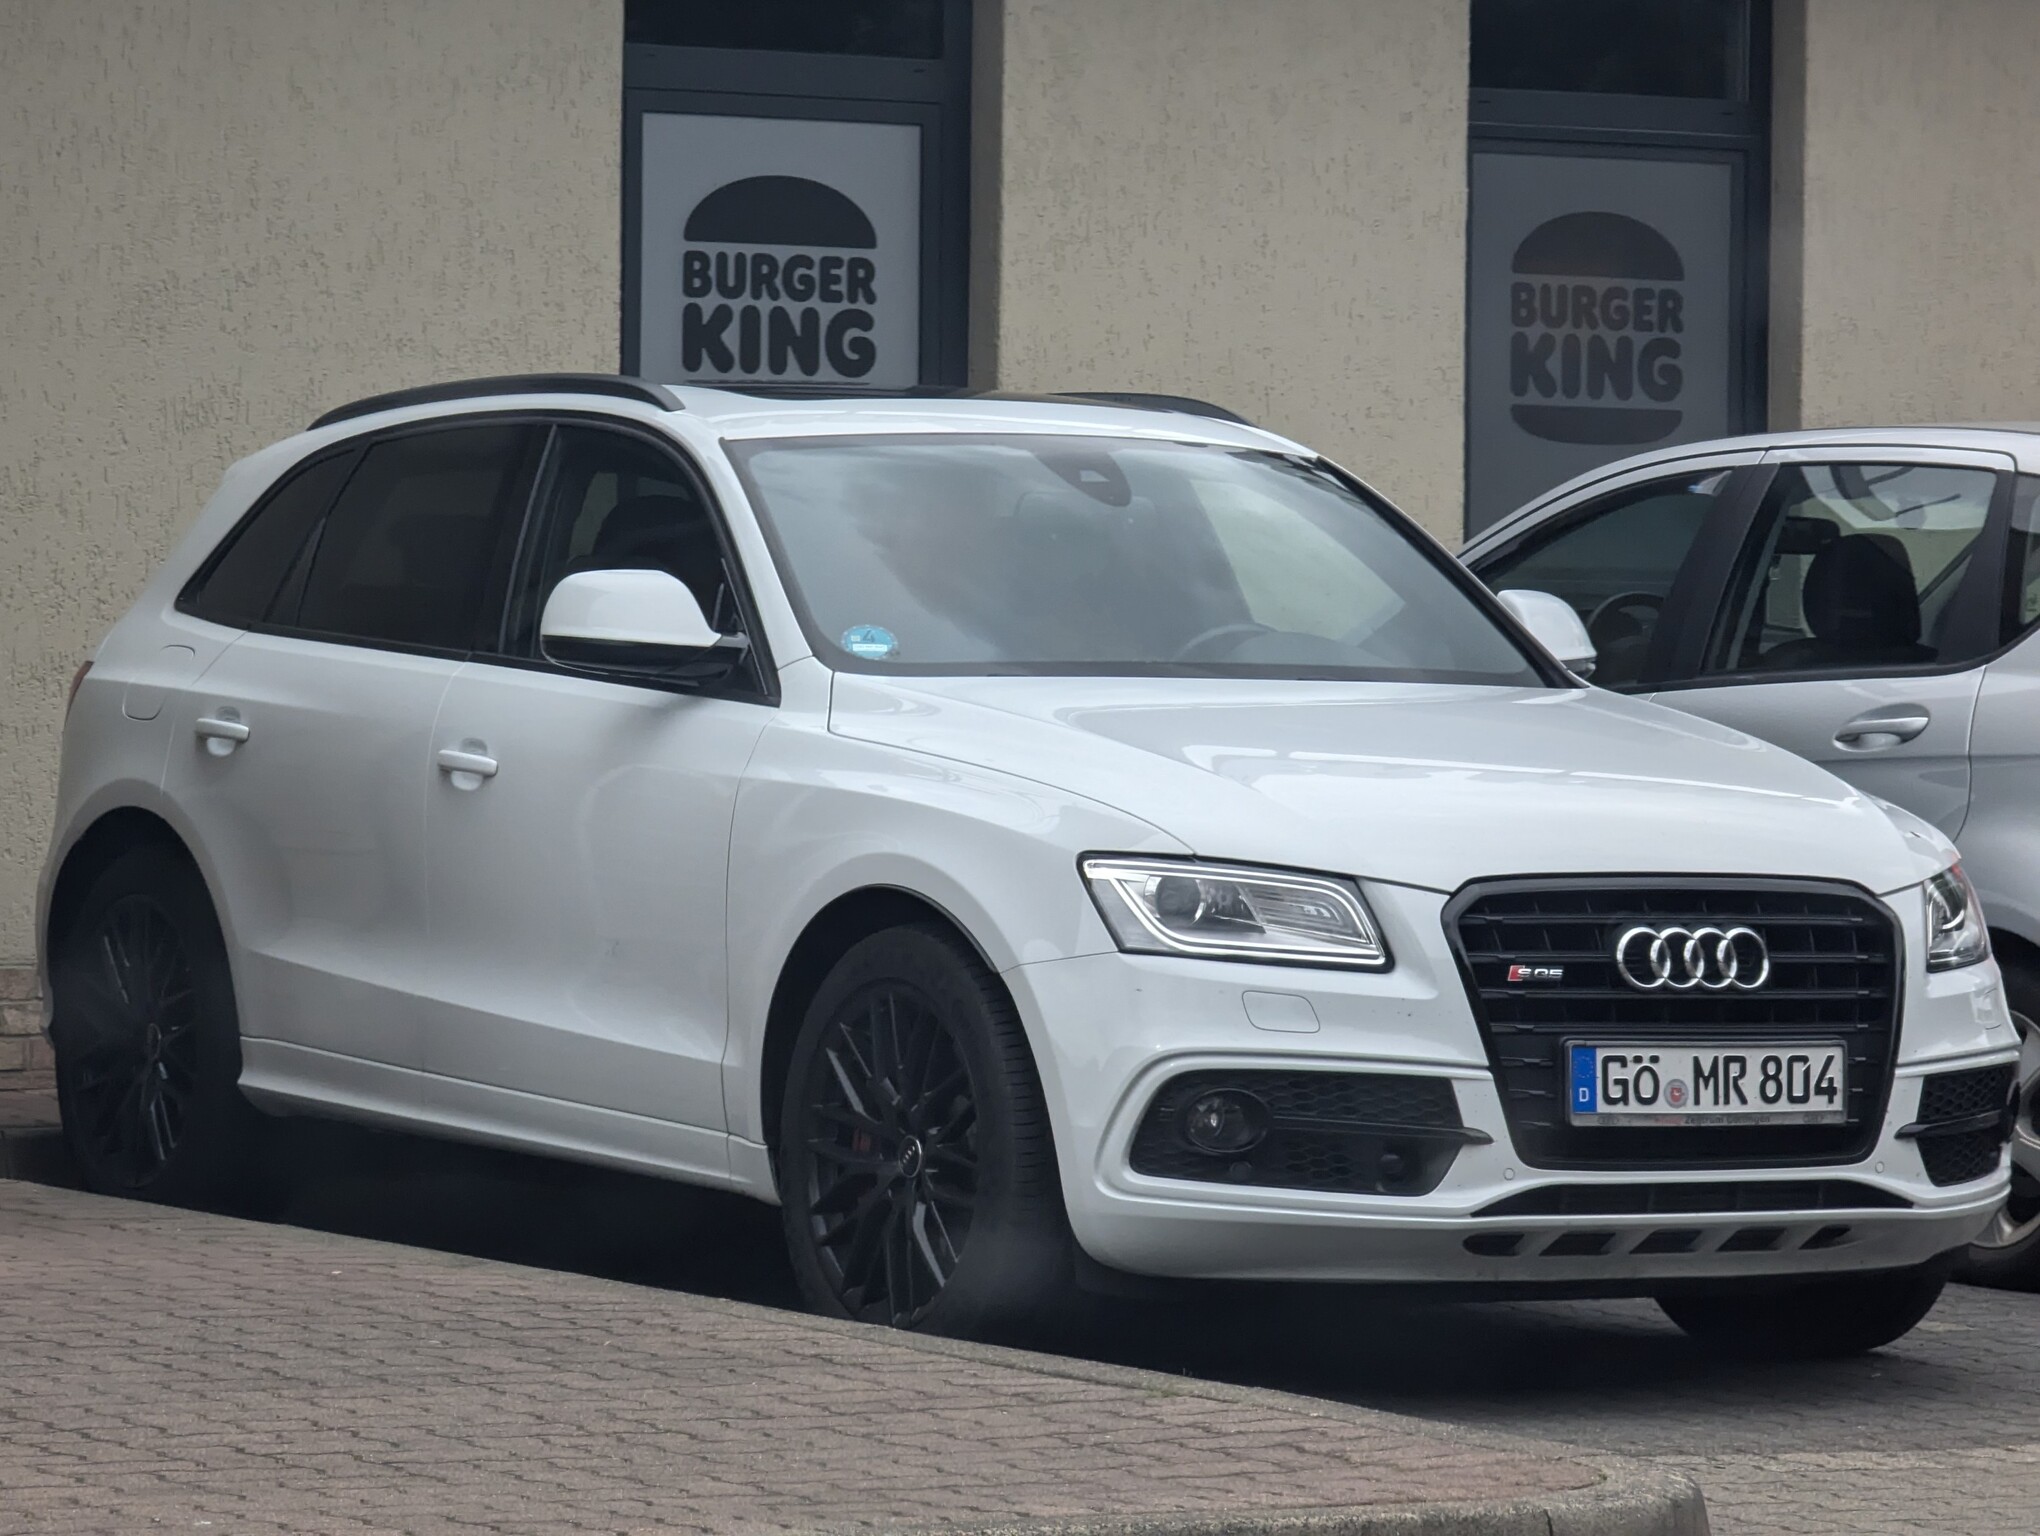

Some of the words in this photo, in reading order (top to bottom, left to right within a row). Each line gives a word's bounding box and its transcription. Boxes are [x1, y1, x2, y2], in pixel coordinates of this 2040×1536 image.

[682, 250, 877, 305] BURGER
[1511, 282, 1684, 334] BURGER
[682, 302, 877, 378] KING
[1510, 331, 1683, 403] KING
[1517, 967, 1563, 979] SQ5
[1579, 1087, 1589, 1102] D
[1601, 1054, 1660, 1106] GÖ
[1692, 1054, 1748, 1106] MR
[1759, 1054, 1837, 1105] 804
